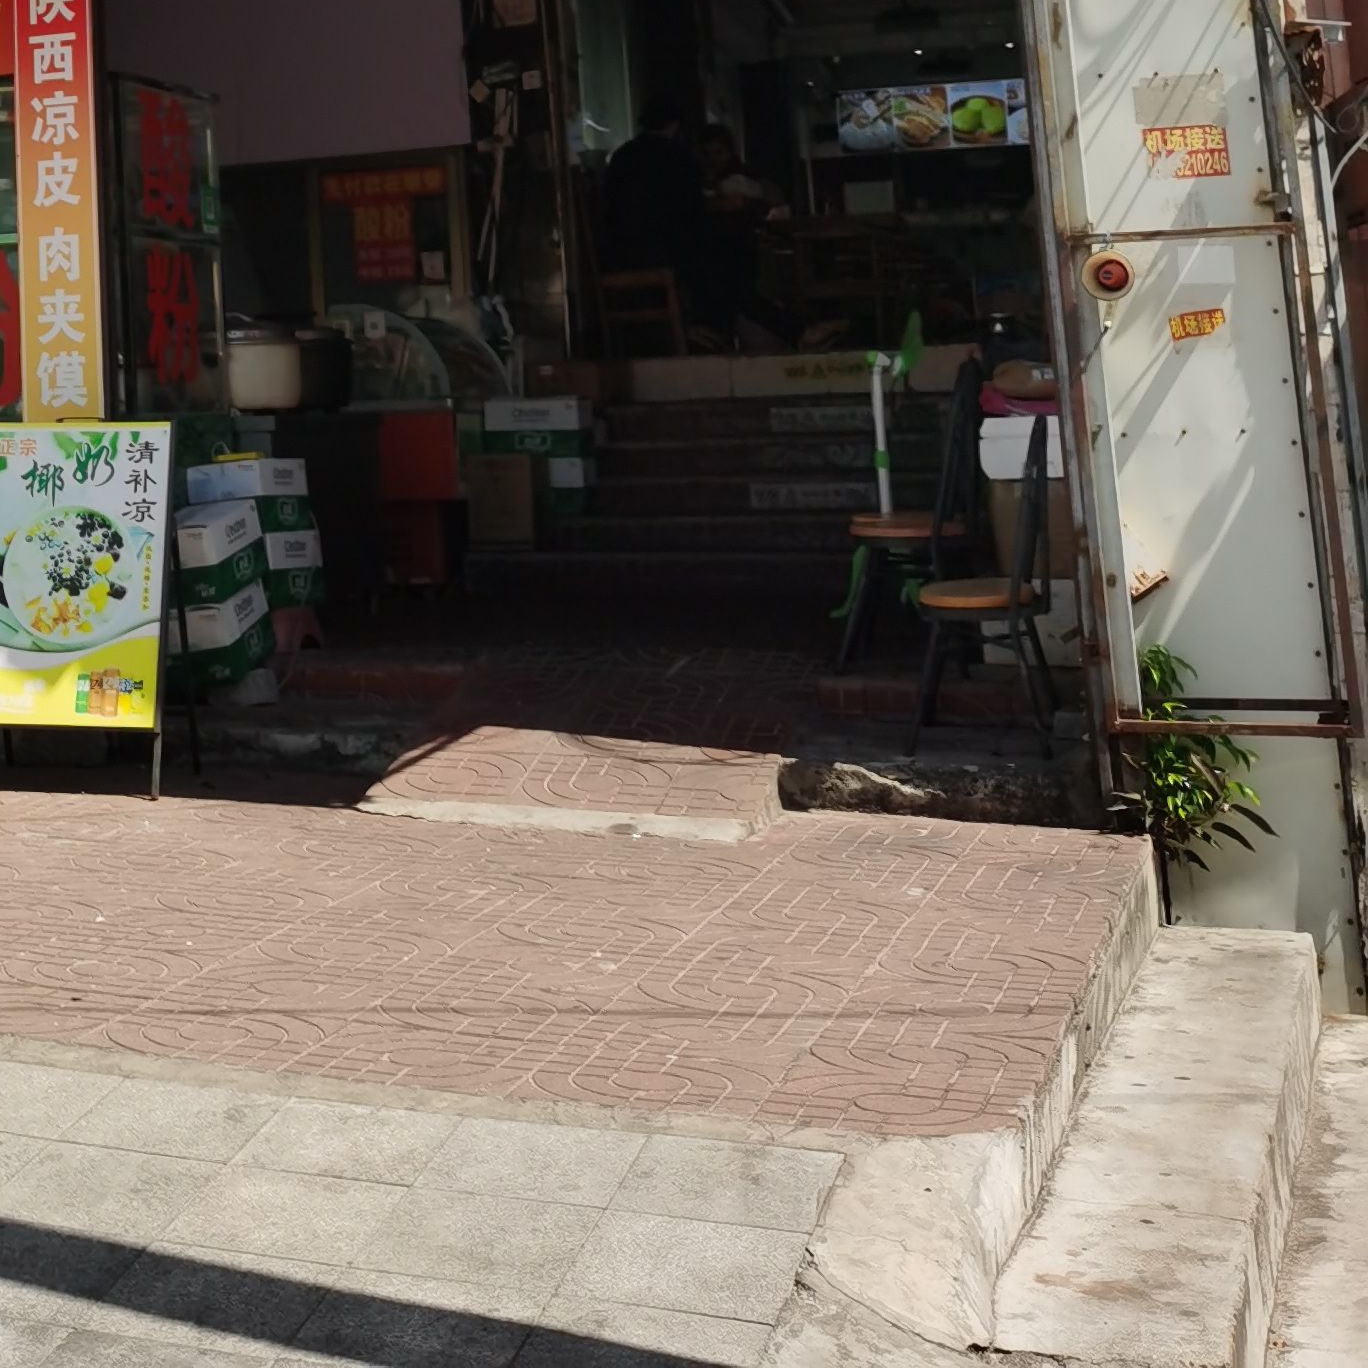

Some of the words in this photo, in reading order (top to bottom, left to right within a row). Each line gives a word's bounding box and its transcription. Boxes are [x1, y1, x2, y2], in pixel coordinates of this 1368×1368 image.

[1145, 126, 1226, 154] 机场接送
[0, 438, 37, 456] 正宗
[21, 442, 115, 507] 椰奶
[122, 441, 159, 522] 清补凉
